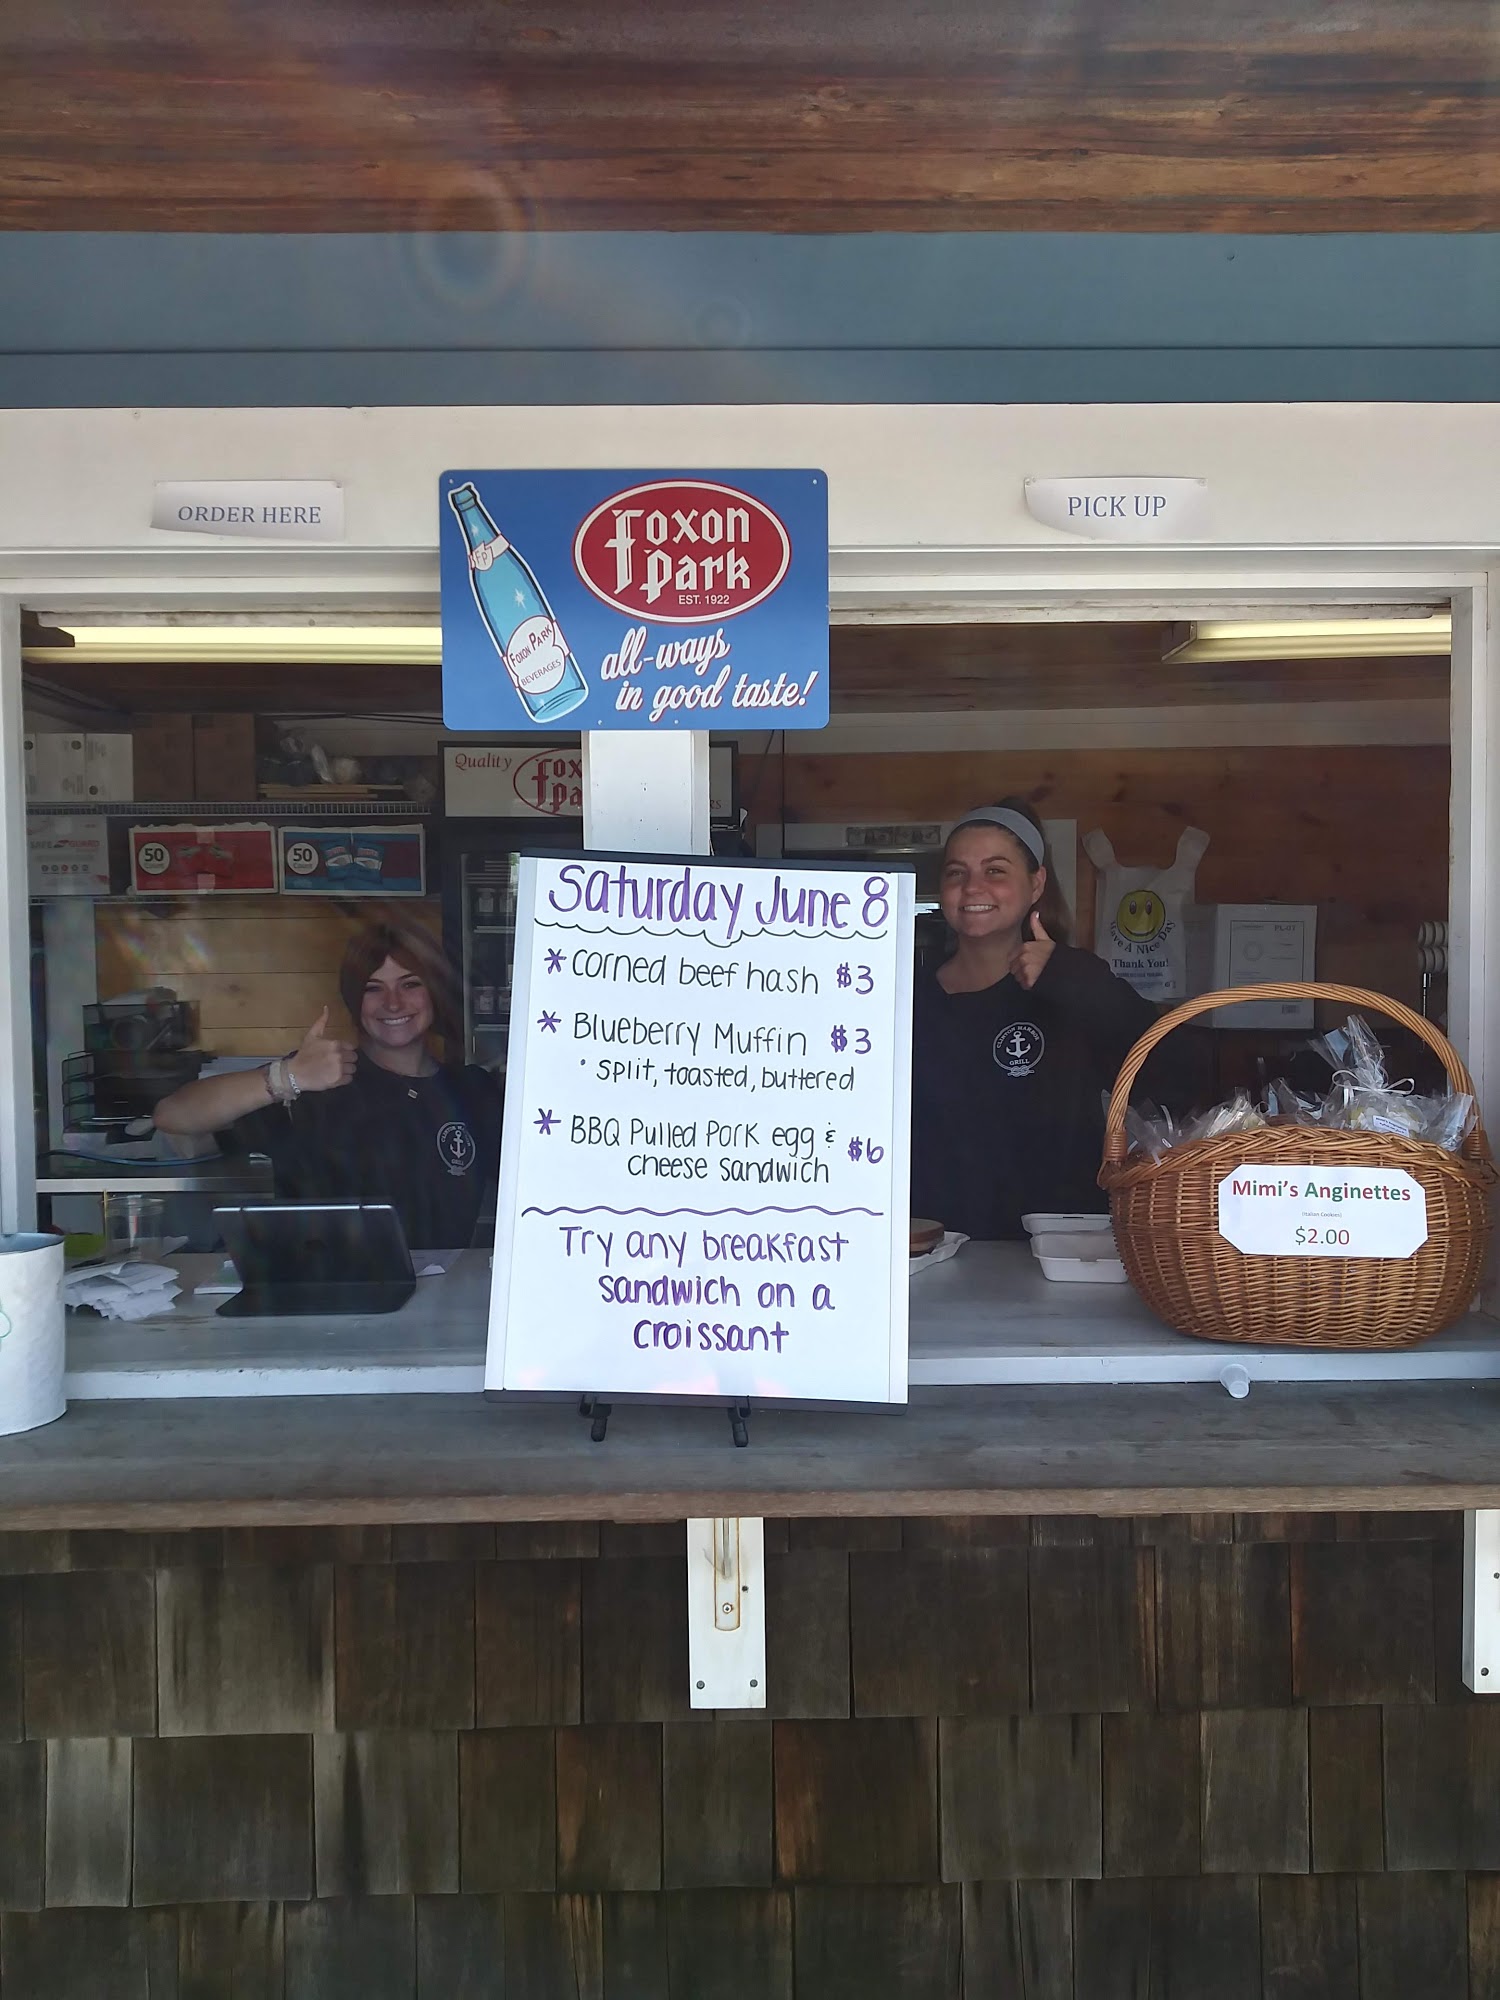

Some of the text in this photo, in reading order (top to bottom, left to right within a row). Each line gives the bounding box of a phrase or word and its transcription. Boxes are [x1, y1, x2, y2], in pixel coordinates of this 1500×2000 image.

[178, 506, 321, 524] ORDER HERE
[1067, 495, 1167, 517] PICK UP
[678, 594, 730, 605] EST. 1922
[600, 626, 731, 678] all-ways
[520, 659, 562, 686] BEVERAGES
[615, 665, 819, 723] in good taste!
[455, 752, 513, 772] Quality
[144, 848, 164, 862] 50
[293, 848, 313, 862] 50
[549, 864, 890, 940] Saturday June 8
[1124, 943, 1132, 953] A
[1136, 942, 1161, 955] Nice
[1158, 919, 1176, 942] Day
[679, 957, 740, 988] beef
[747, 961, 819, 995] hash
[836, 962, 875, 995] $3
[1112, 957, 1169, 968] Thank You!
[573, 1012, 872, 1056] Blueberry Muffin $3
[996, 1025, 1040, 1049] CLINTON HARBOR
[761, 1066, 854, 1091] buttered
[570, 1114, 620, 1147] BBQ
[630, 1118, 697, 1148] Pulled
[772, 1125, 815, 1160] egg
[847, 1136, 885, 1164] $6
[627, 1154, 829, 1184] cheese sandwich
[1304, 1182, 1411, 1203] Anginettes
[559, 1226, 850, 1268] Try any breakfast
[1295, 1226, 1350, 1246] $2.00
[598, 1274, 836, 1311] sandwich on a
[633, 1319, 790, 1354] croissant
